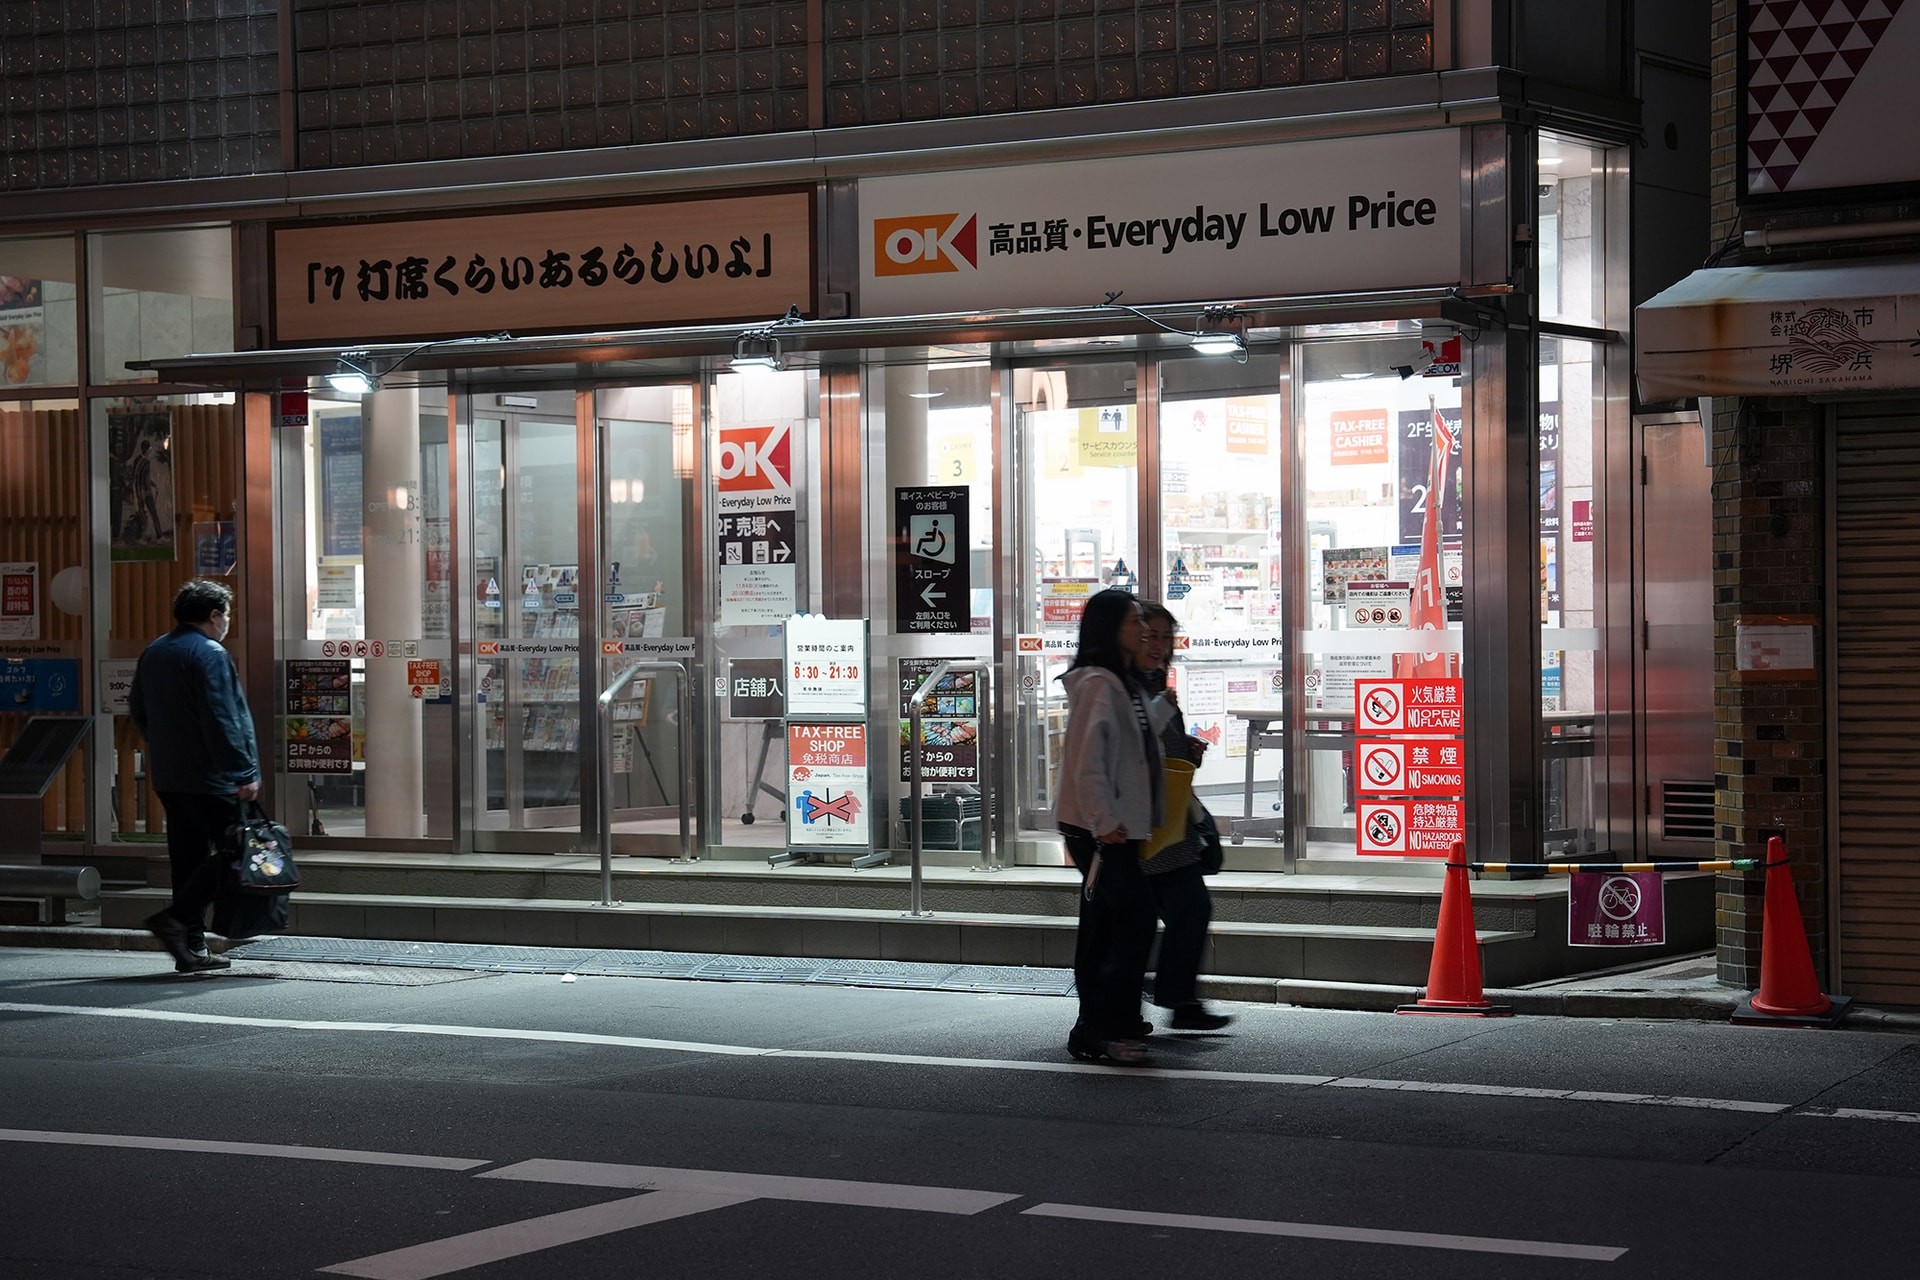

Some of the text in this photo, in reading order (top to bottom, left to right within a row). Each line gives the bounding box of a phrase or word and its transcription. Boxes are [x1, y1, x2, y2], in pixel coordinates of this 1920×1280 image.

[1260, 201, 1335, 237] Low
[1348, 190, 1437, 231] Price
[882, 212, 977, 274] OK
[1770, 310, 1797, 323] 株式
[1770, 325, 1797, 337] 会社
[1819, 375, 1873, 384] SAKAHAMA
[1332, 418, 1385, 433] TAX-FREE
[1335, 434, 1383, 448] CASHIER
[952, 459, 962, 477] 3
[756, 496, 772, 506] Low
[773, 494, 791, 505] Price
[735, 516, 782, 537] 売場へ
[914, 567, 951, 579] スロープ
[915, 611, 951, 620] 左側入口を
[909, 621, 958, 629] ご利用ください
[479, 642, 499, 655] OK
[549, 644, 563, 652] Low
[602, 641, 624, 655] OK
[796, 644, 854, 653] 営業時間のご案内
[1020, 637, 1043, 651] OK
[1252, 638, 1269, 646] Low
[408, 661, 439, 670] TAX-FREE
[794, 666, 818, 679] 8:30
[829, 666, 858, 679] 21:30
[288, 678, 300, 689] 2F
[902, 679, 916, 691] 2F
[1411, 685, 1457, 704] 火気厳禁
[289, 700, 300, 710] 1F
[1407, 708, 1461, 728] NO OPEN
[1420, 718, 1461, 728] FLAME
[792, 726, 862, 739] TAX-FREE
[809, 739, 845, 753] SHOP
[288, 758, 350, 769] お買物が便利です
[802, 752, 853, 765] 免税商店
[902, 766, 975, 777] お物が便利です
[1408, 769, 1461, 789] NO SMOKING
[1412, 803, 1458, 817] 危険物品
[1412, 816, 1458, 829] 持込厳禁
[1409, 831, 1462, 850] NO HAZARDOUS
[1587, 922, 1648, 940] 駐輪禁止
